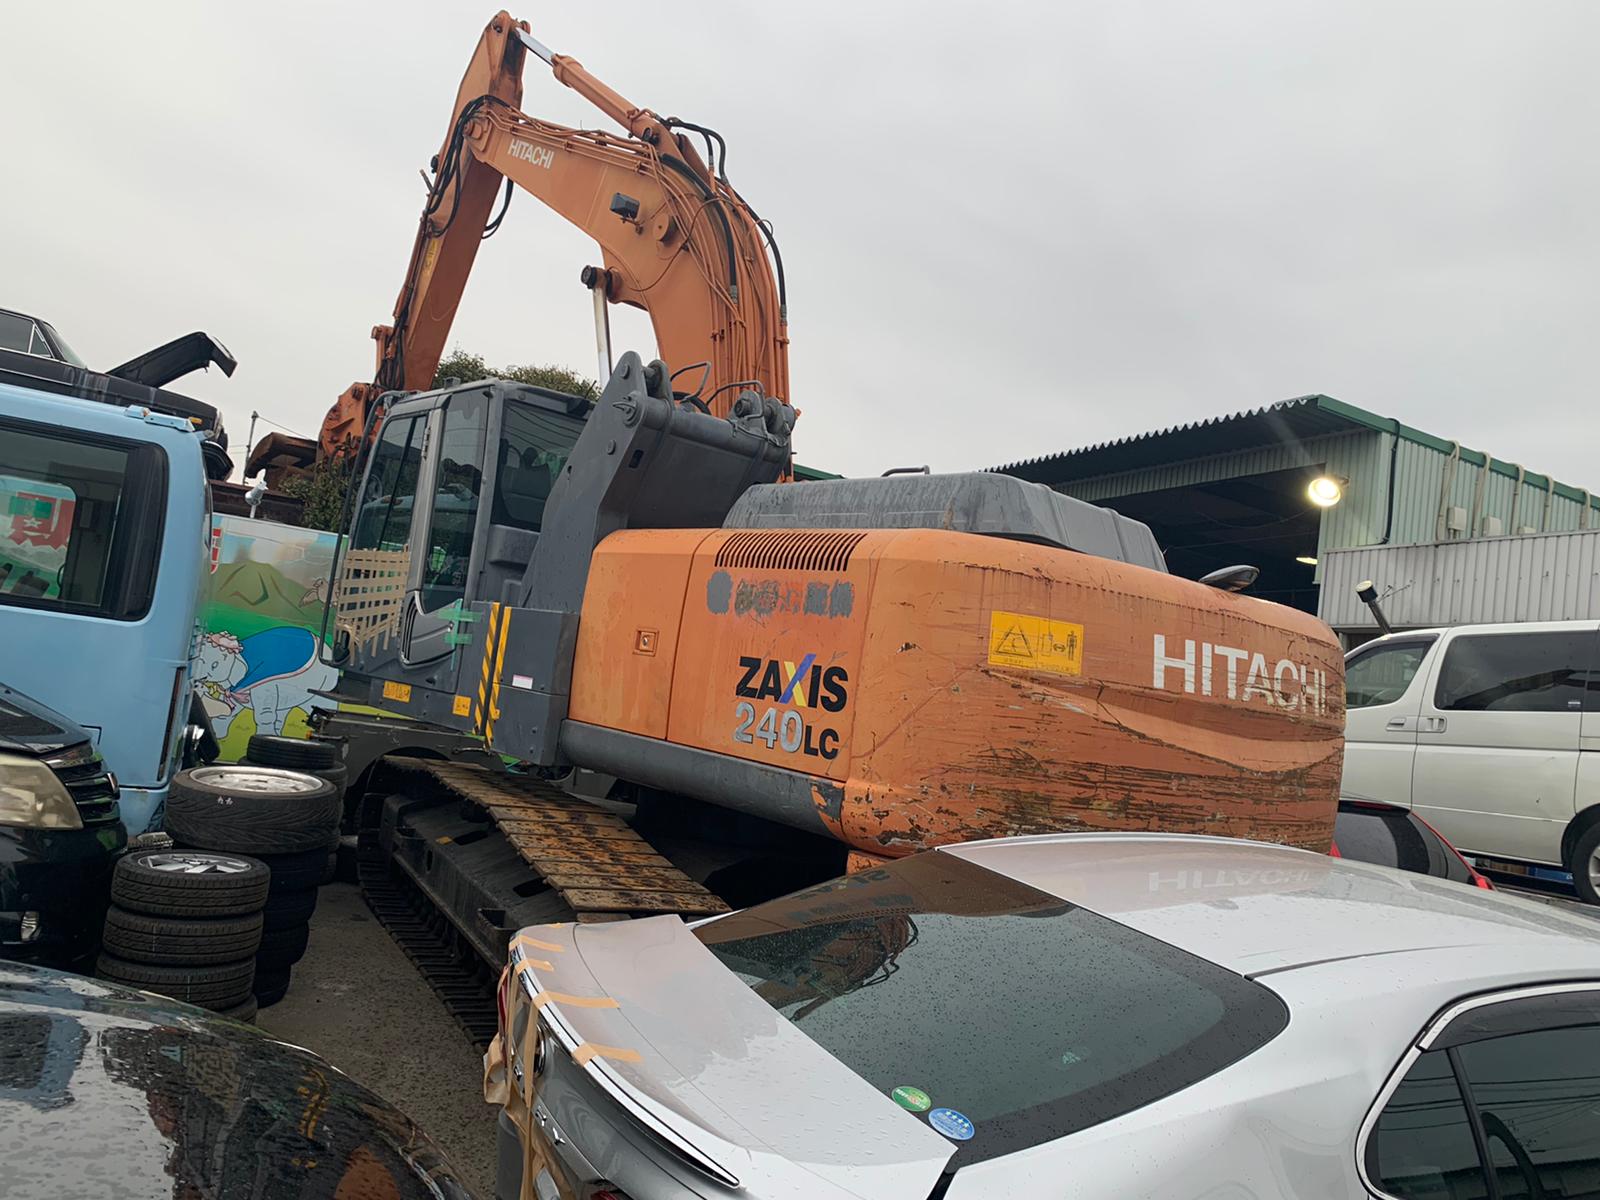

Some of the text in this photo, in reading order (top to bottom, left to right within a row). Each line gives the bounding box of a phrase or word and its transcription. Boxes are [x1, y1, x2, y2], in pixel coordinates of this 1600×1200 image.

[507, 138, 554, 169] HITACHI
[735, 653, 849, 713] ZAXIS
[1153, 634, 1326, 716] HITACHI
